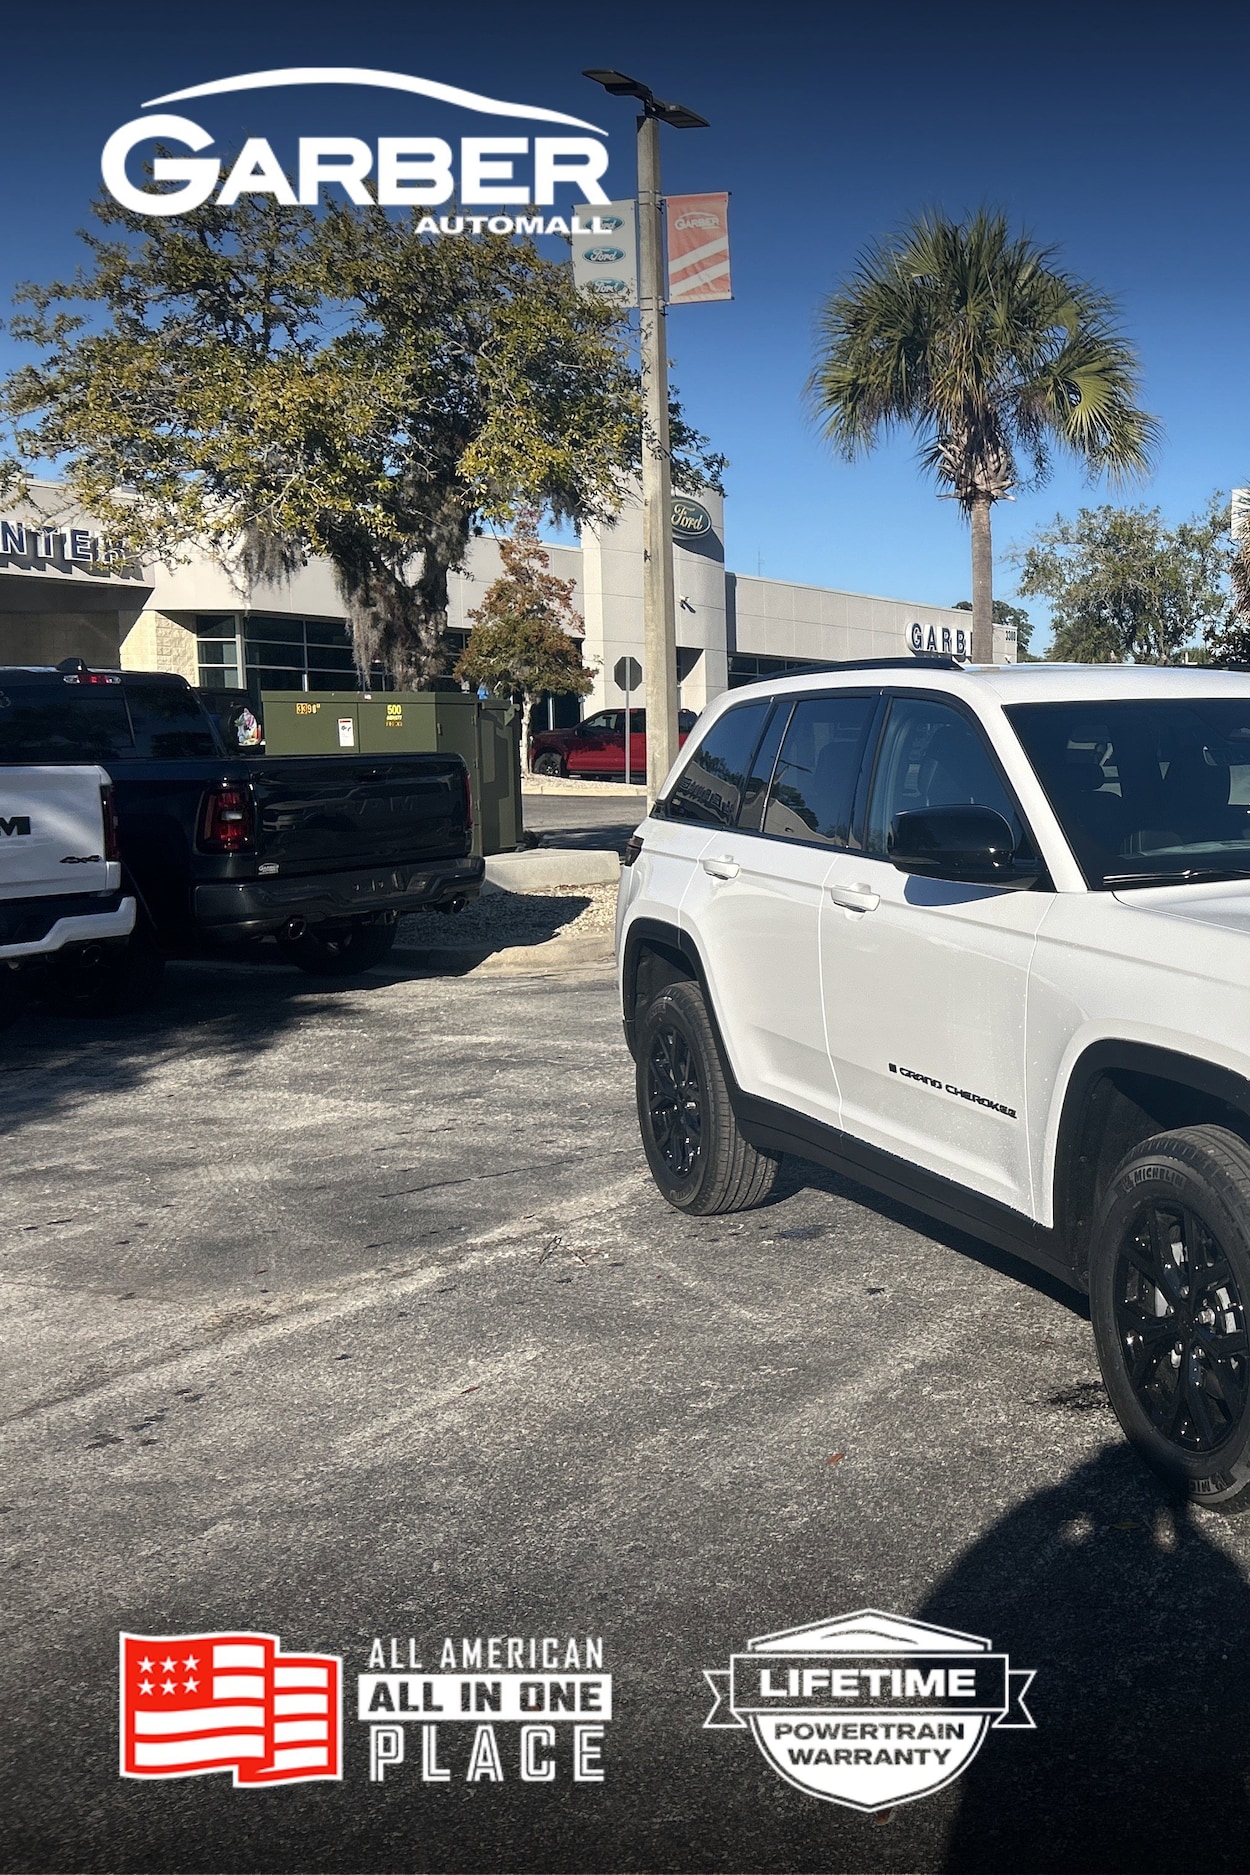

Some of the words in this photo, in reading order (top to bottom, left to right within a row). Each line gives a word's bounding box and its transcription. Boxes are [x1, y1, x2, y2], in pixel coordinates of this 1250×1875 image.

[674, 216, 720, 231] GARBER
[590, 248, 617, 262] Ford
[671, 503, 703, 531] Ford
[906, 622, 973, 656] GARB
[387, 704, 402, 715] 500
[899, 1067, 943, 1089] GRAND
[945, 1084, 1018, 1119] CHEROKEE
[1133, 1167, 1184, 1187] MICHELIN
